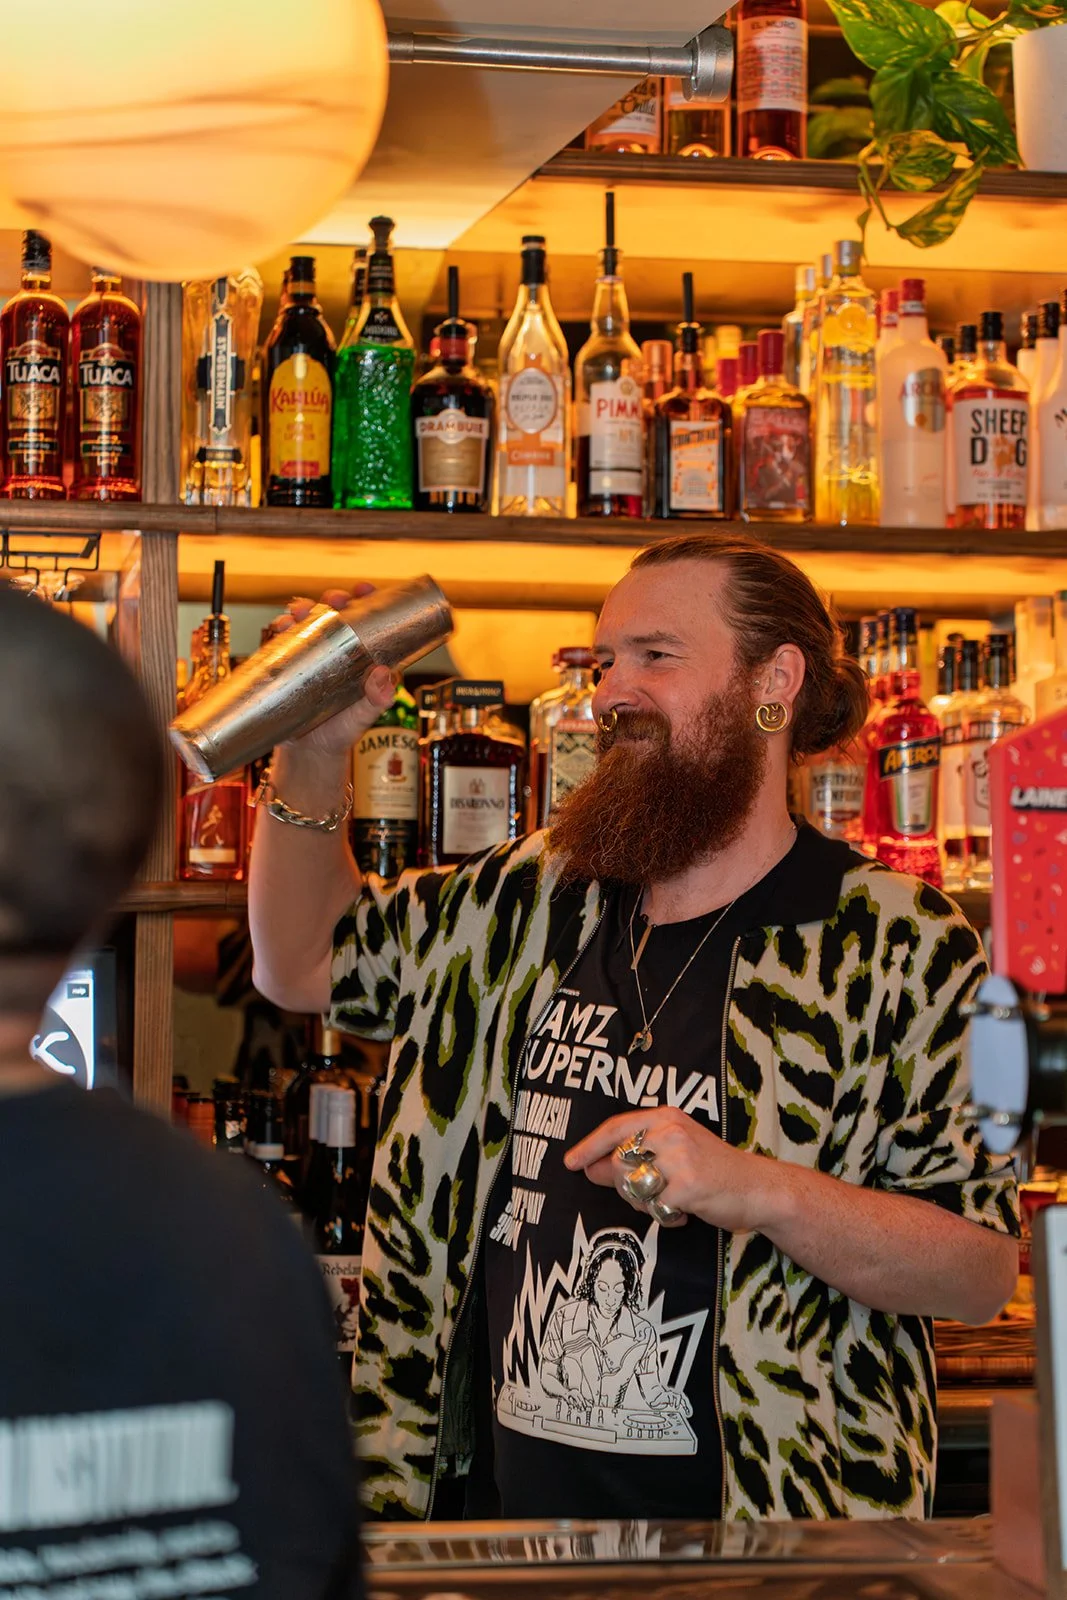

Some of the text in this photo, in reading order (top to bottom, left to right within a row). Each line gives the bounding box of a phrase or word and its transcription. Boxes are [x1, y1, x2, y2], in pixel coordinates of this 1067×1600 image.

[7, 361, 60, 384] TUACA
[80, 363, 133, 386] TUACA
[971, 408, 1027, 434] SHEEP
